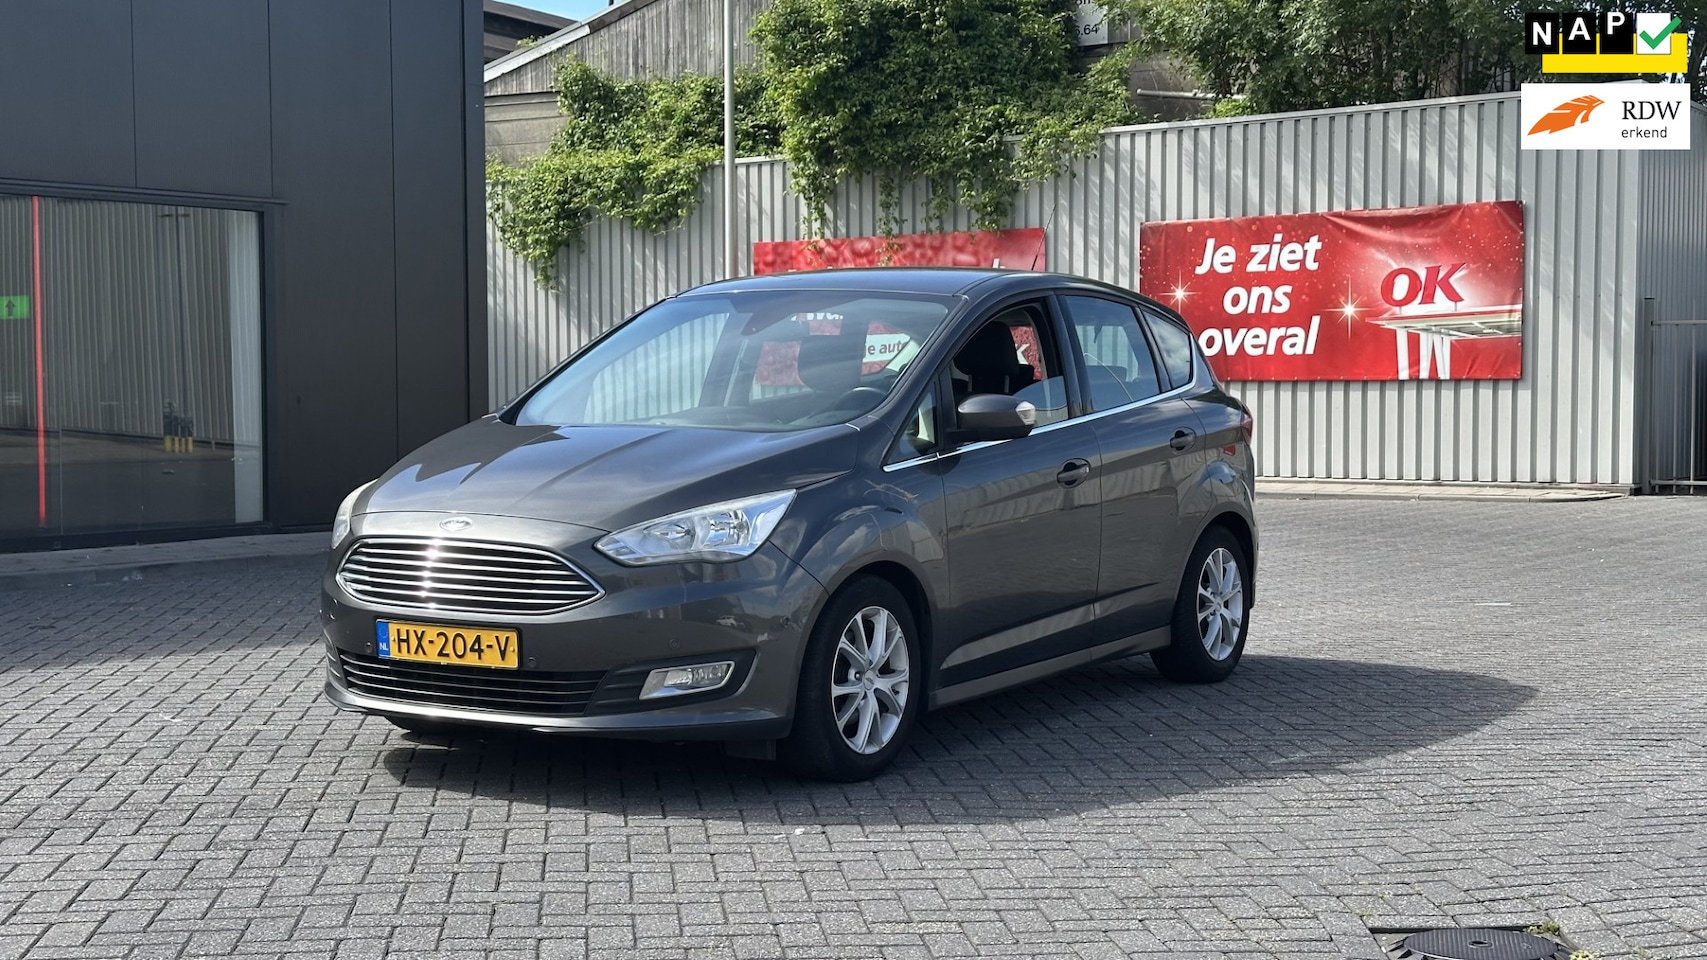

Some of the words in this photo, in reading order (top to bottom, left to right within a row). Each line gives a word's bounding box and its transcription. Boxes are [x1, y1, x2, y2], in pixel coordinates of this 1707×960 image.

[1195, 237, 1236, 275] Je
[1245, 231, 1322, 273] ziet
[1222, 282, 1292, 315] ons
[1380, 262, 1466, 307] OK
[1198, 315, 1321, 357] overal
[380, 642, 389, 651] NL
[396, 628, 510, 661] HX-204-V
